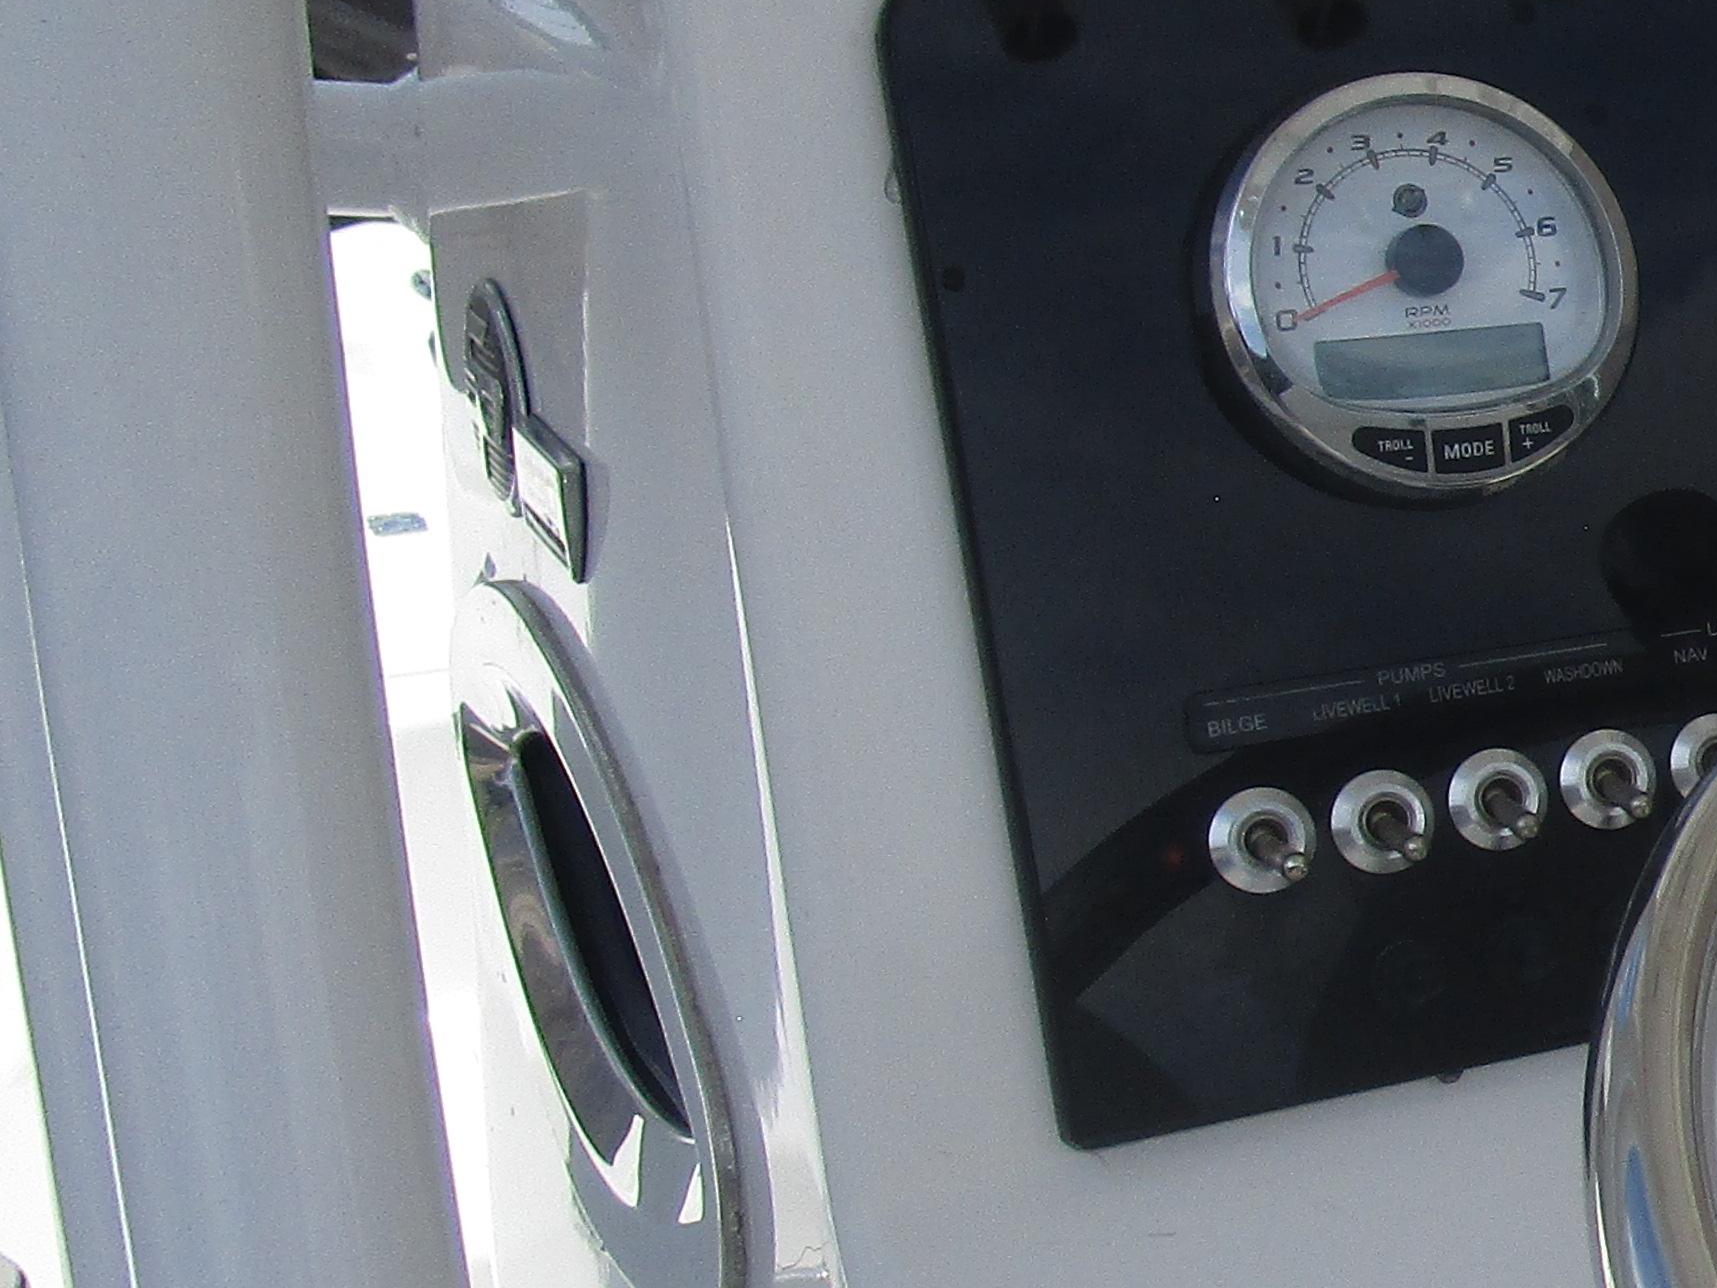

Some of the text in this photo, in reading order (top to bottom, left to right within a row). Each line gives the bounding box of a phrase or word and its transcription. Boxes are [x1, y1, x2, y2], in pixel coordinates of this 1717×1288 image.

[1351, 133, 1371, 151] 3
[1427, 130, 1449, 147] 4
[1294, 167, 1315, 185] 2
[1493, 157, 1514, 175] 5
[1536, 216, 1557, 237] 6
[1272, 236, 1282, 256] 1
[1549, 287, 1569, 309] 7
[1404, 303, 1451, 320] RPM
[1518, 421, 1552, 436] TROLL
[1377, 437, 1414, 453] TROLL
[1443, 438, 1496, 460] MODE
[1673, 646, 1709, 665] NAV
[1376, 661, 1447, 687] PUMPS
[1543, 658, 1624, 685] WASHDOWN
[1428, 674, 1516, 705] LIVEWELL 2
[1312, 694, 1391, 722] LIVEWELL
[1206, 713, 1268, 739] BILGE
